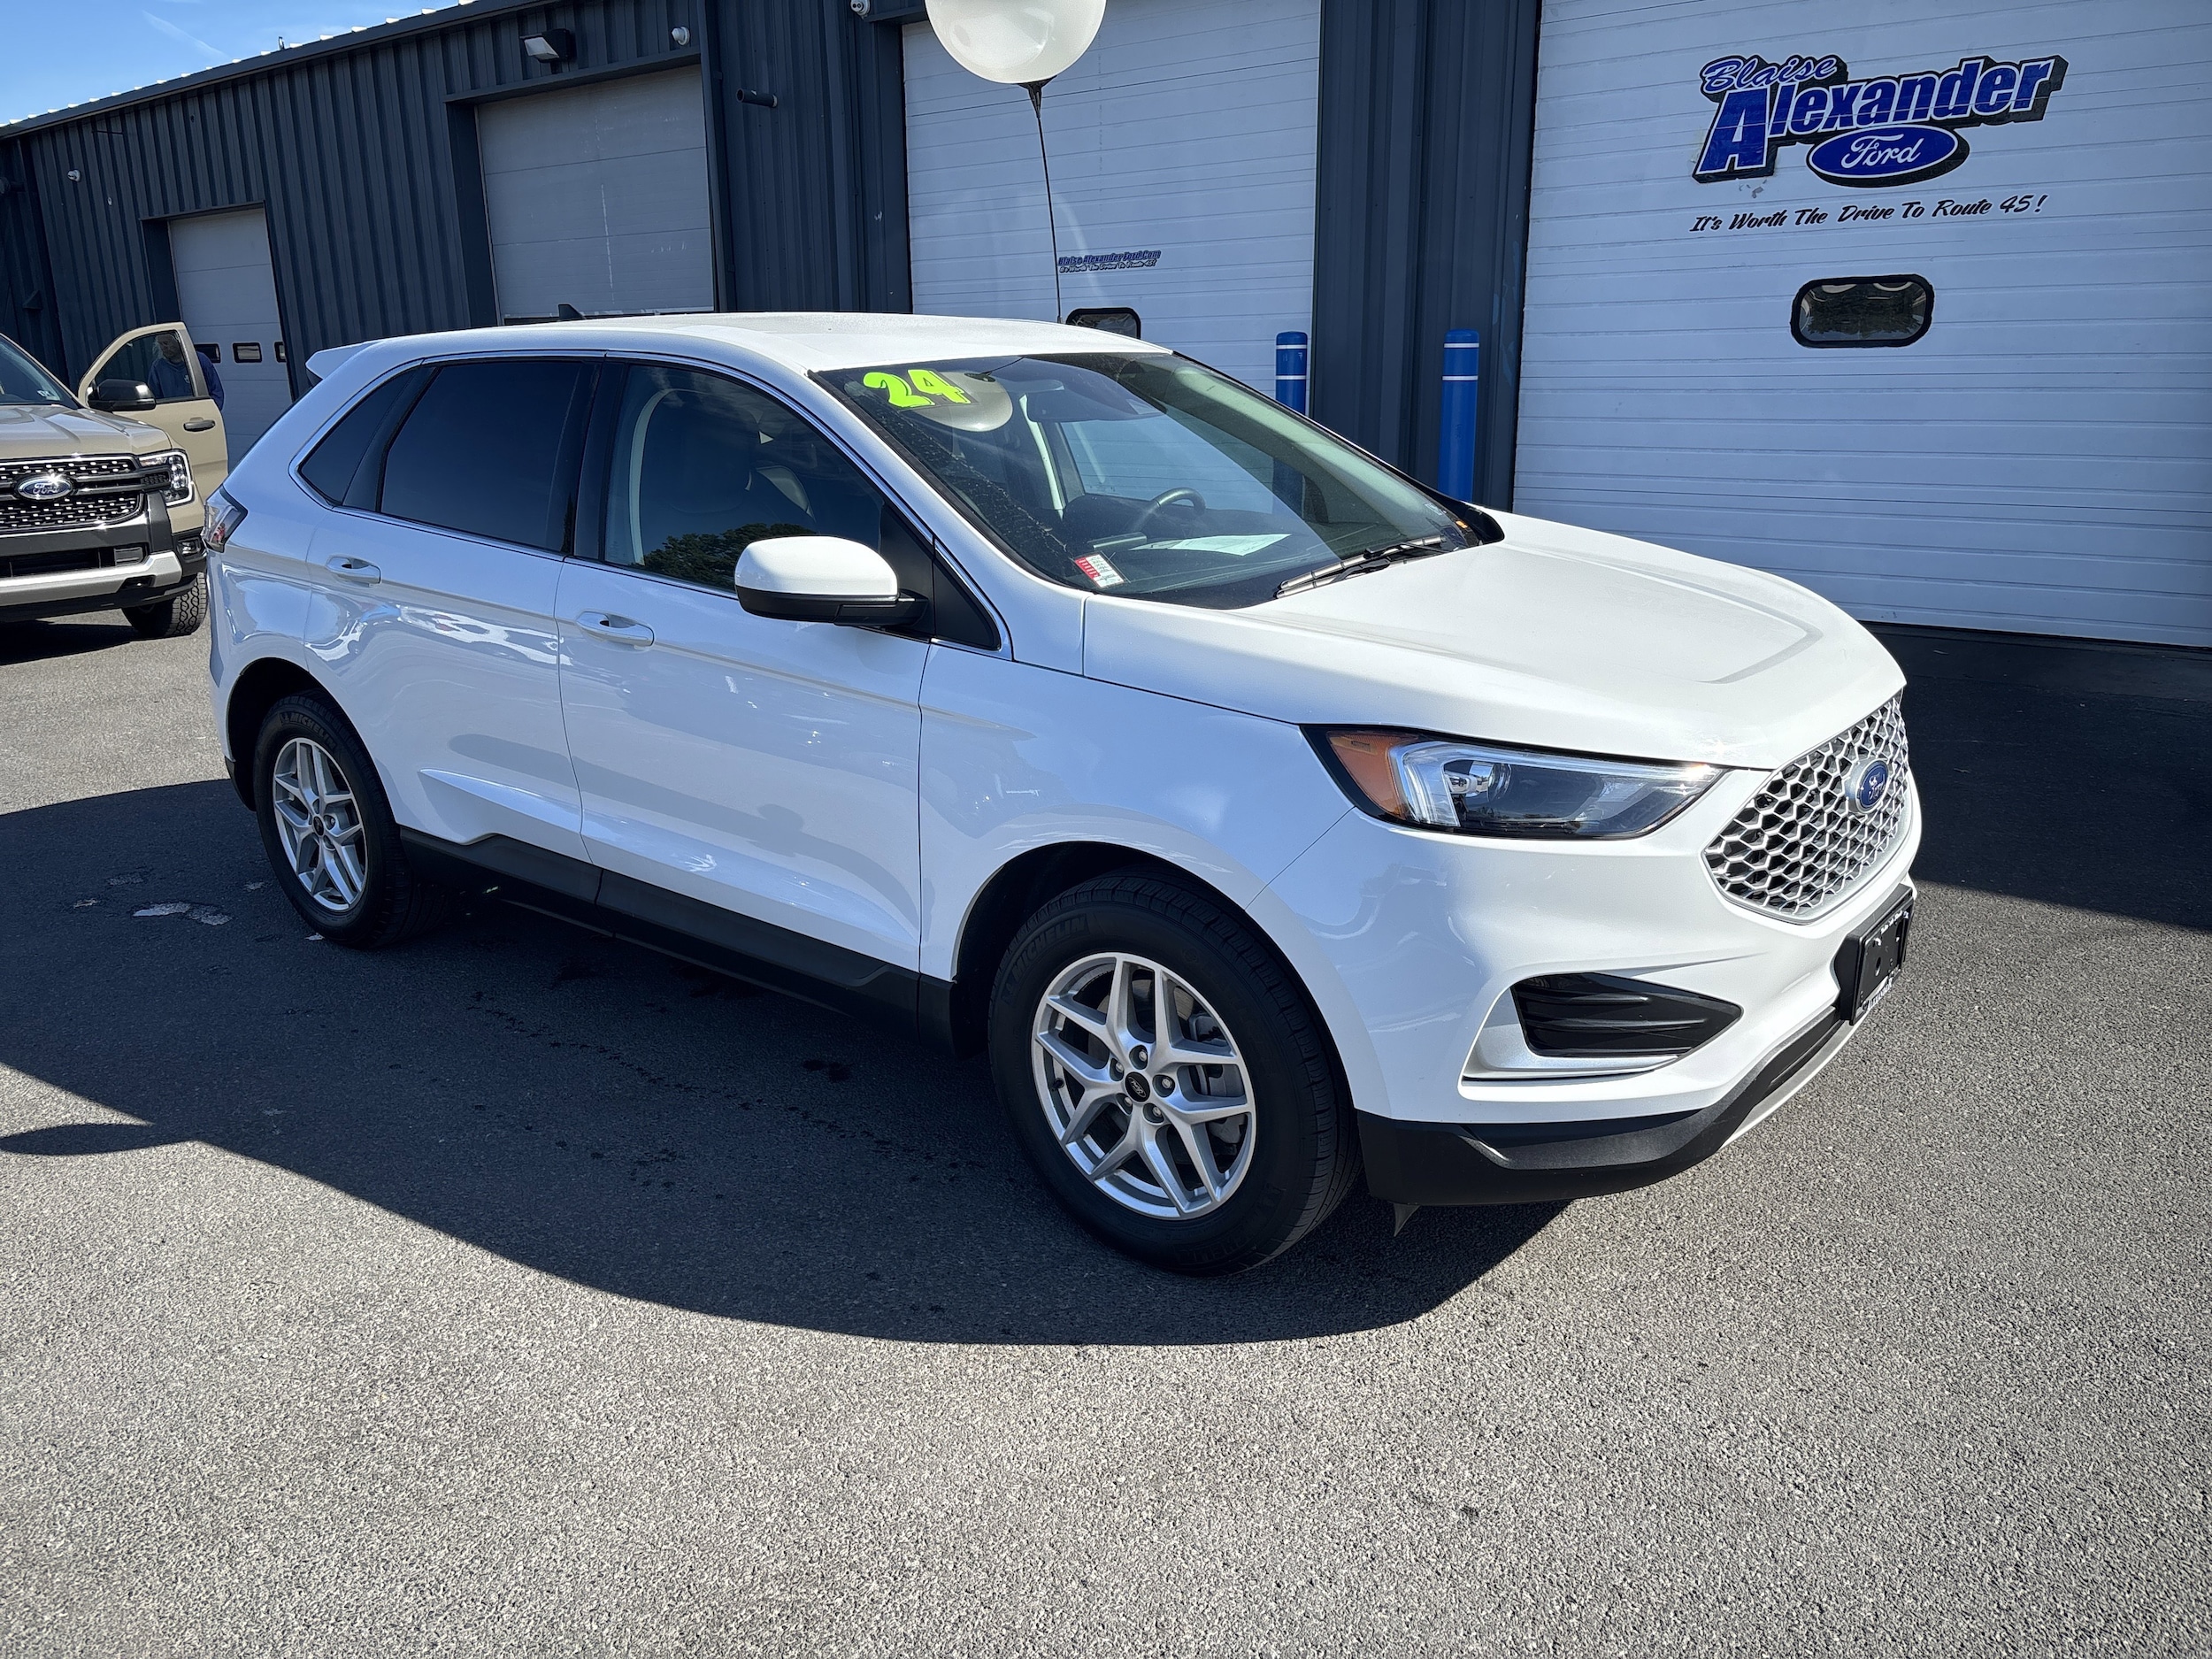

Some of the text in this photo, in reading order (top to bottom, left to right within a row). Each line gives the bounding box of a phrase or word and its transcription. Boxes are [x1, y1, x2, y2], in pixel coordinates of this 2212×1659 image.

[1702, 54, 1838, 93] Blaise
[1695, 57, 2056, 176] Alexander
[1840, 133, 1922, 169] Ford
[1690, 194, 2049, 233] It's Worth The Drive To Route 45!
[863, 369, 972, 408] 24
